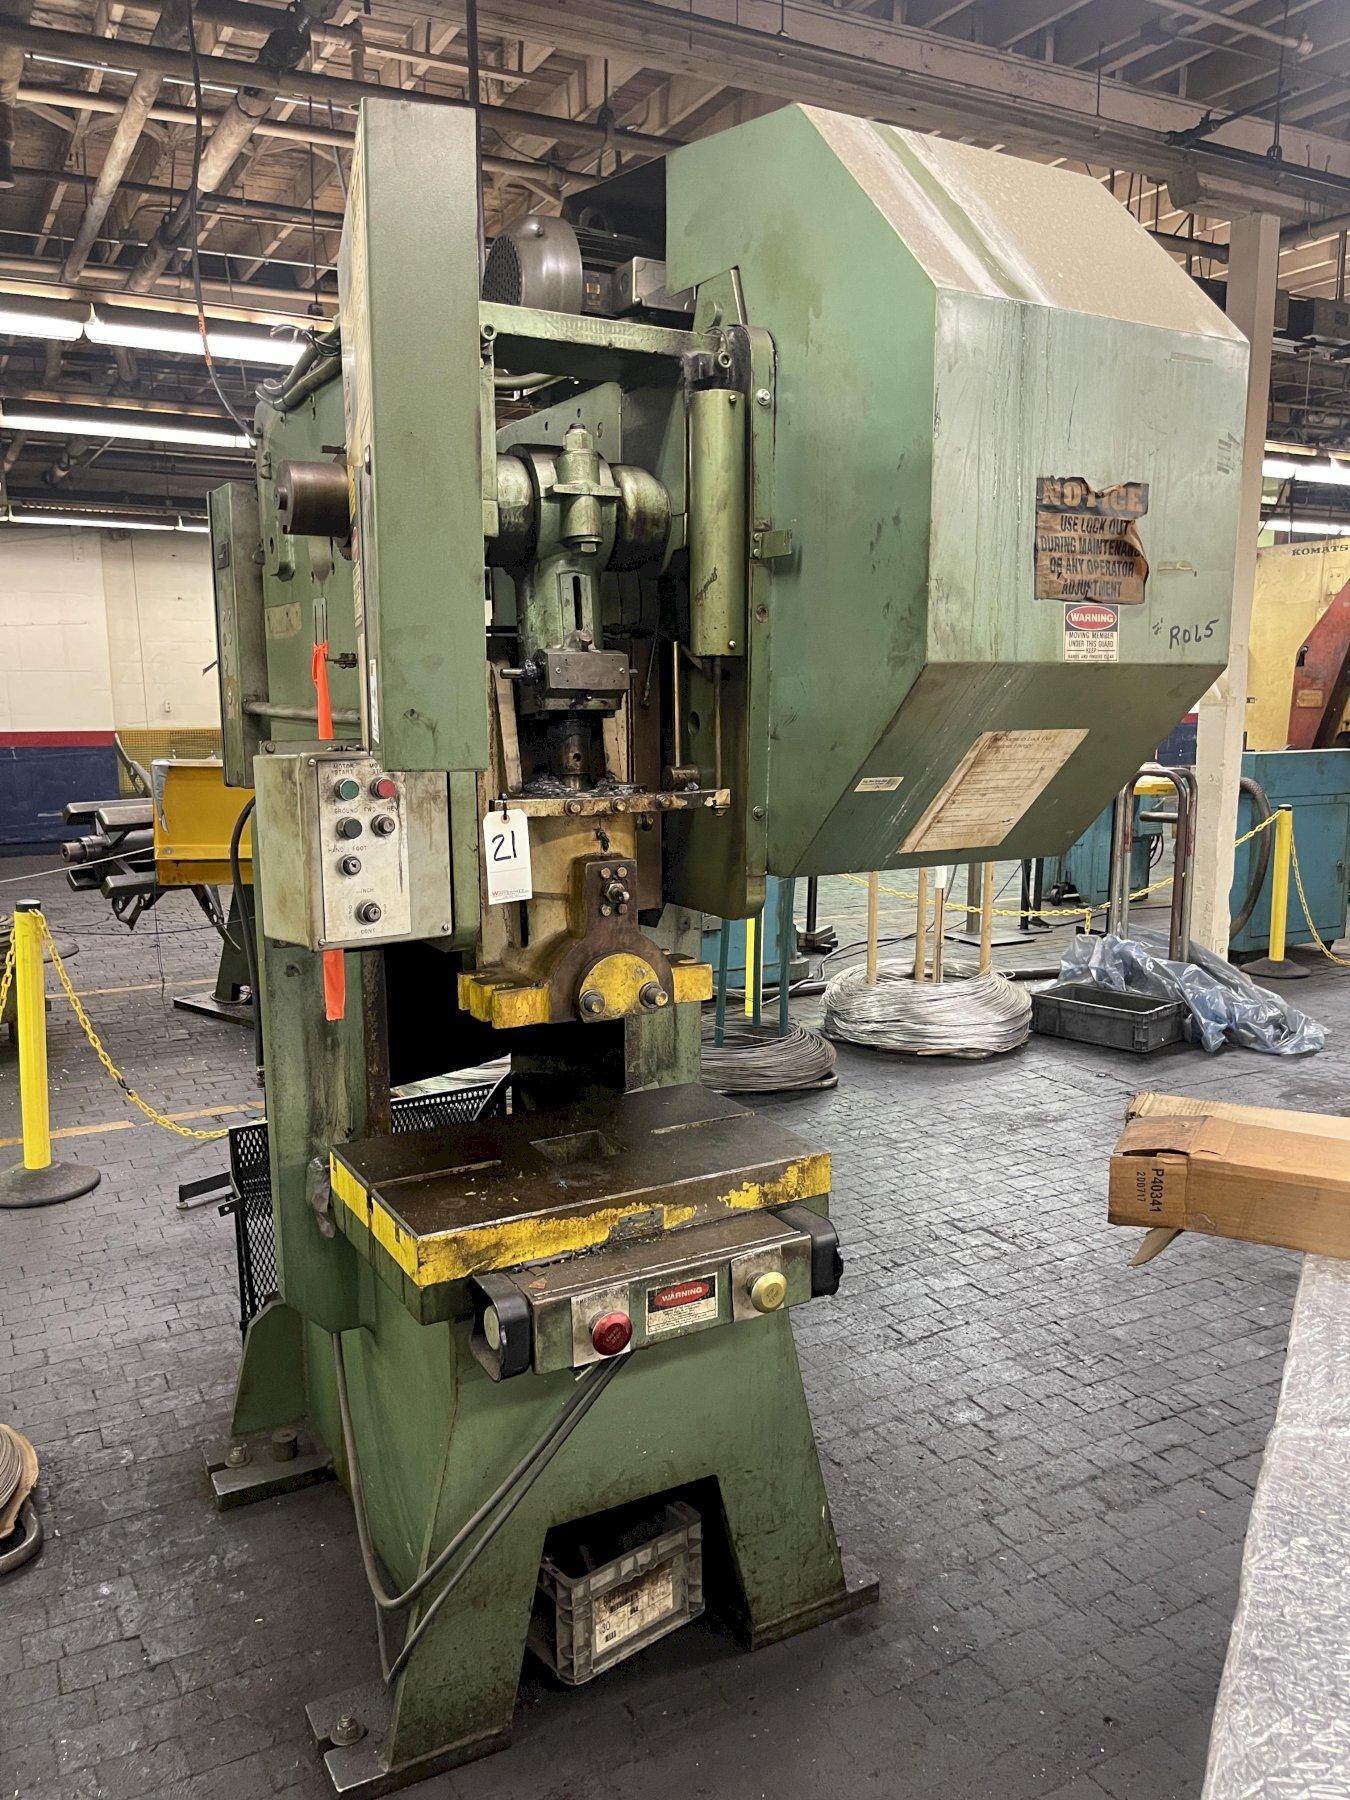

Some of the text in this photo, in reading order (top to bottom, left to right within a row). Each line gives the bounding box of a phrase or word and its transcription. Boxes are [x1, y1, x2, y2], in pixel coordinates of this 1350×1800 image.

[1060, 515, 1129, 535] USE LOCK OUT
[1040, 535, 1077, 553] DURING
[1049, 556, 1135, 578] OR ANY OPERATOR
[1061, 580, 1122, 598] ADJUSTMENT
[1070, 612, 1114, 623] WARNING
[1068, 631, 1090, 639] MOVING
[1068, 640, 1114, 648] UNDER THIS GUARD
[491, 830, 517, 862] 21
[1136, 1171, 1146, 1202] 200717
[1149, 1168, 1165, 1212] P40341
[661, 1286, 703, 1302] WARNING
